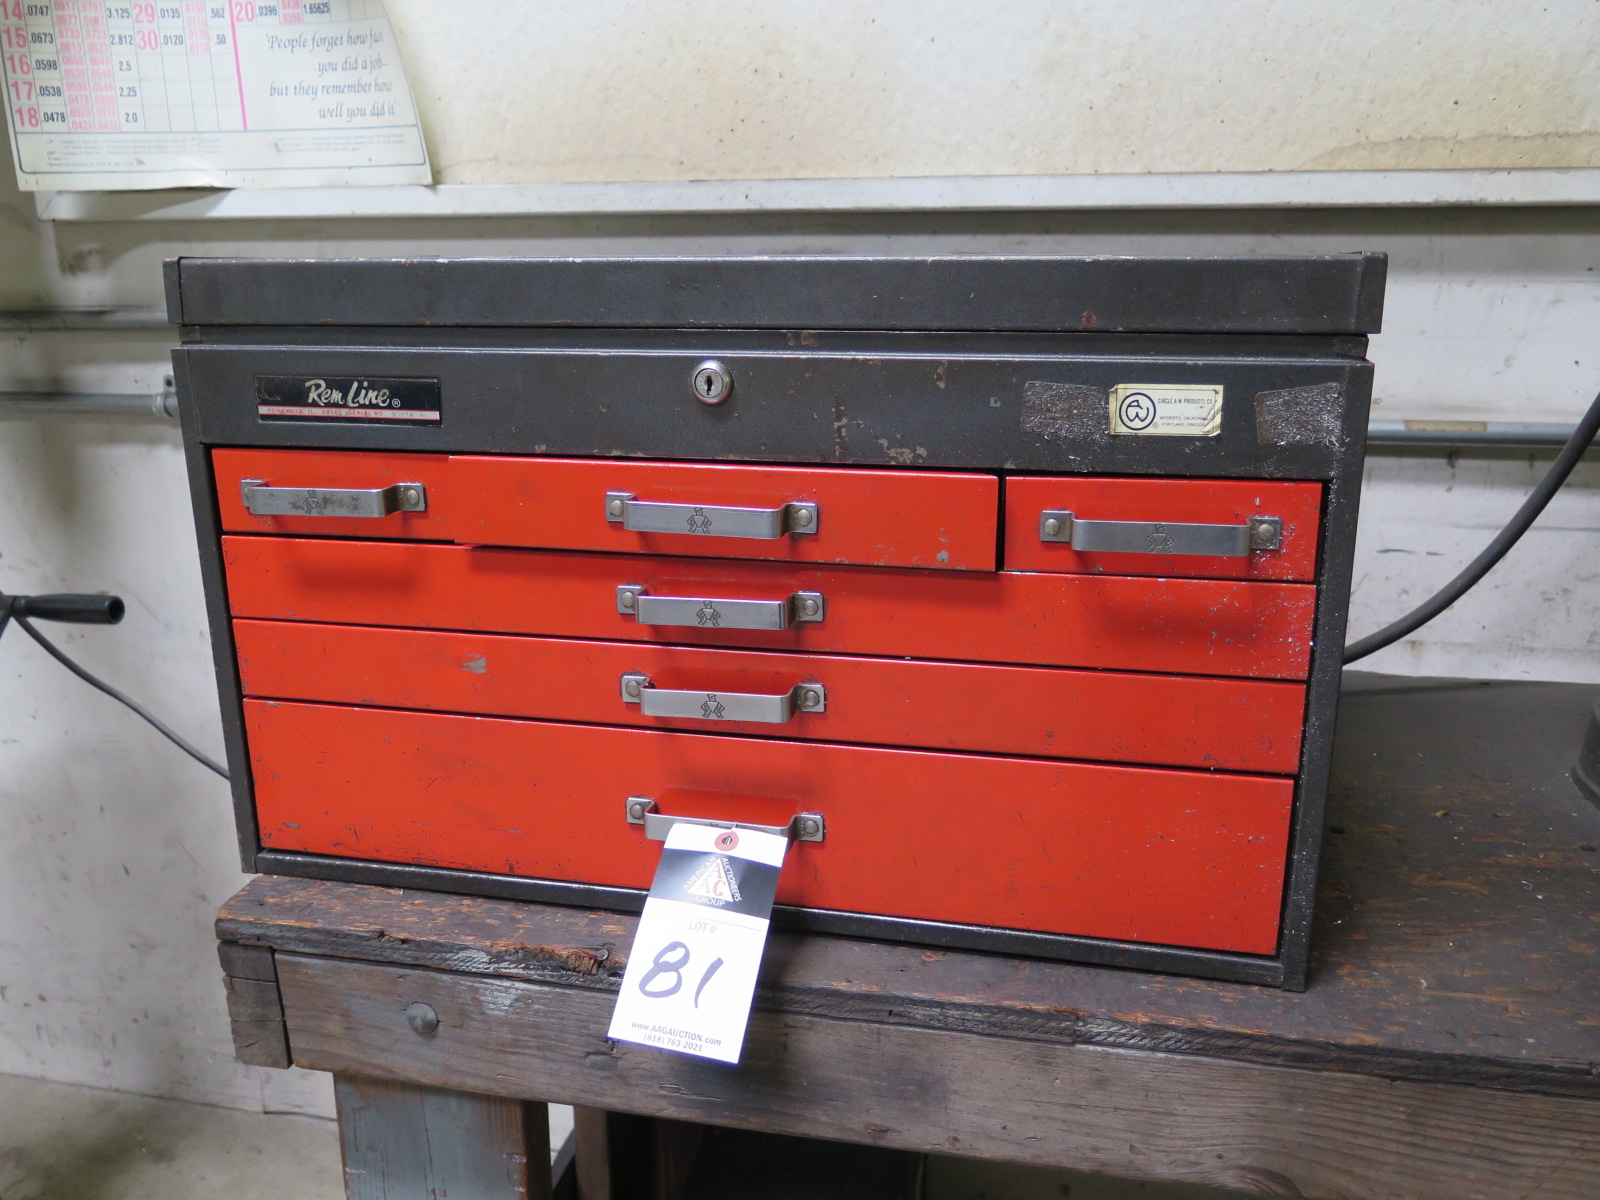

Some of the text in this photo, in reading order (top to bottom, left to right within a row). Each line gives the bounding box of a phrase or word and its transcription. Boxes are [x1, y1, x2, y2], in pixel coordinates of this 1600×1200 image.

[0, 0, 49, 21] 14 .0747
[107, 7, 131, 19] 3.125
[133, 3, 156, 24] 29
[158, 7, 181, 19] .0135
[234, 1, 255, 22] 20
[257, 5, 278, 16] .0396
[2, 27, 54, 48] 15 .0673
[110, 30, 184, 51] 2.812 30 .0120
[214, 34, 227, 45] .50
[309, 30, 344, 53] forget
[347, 29, 367, 46] how
[6, 54, 58, 76] 16 .0598
[118, 60, 132, 72] 2.5
[317, 61, 338, 78] you
[342, 55, 359, 71] did
[361, 59, 368, 71] a
[10, 80, 62, 101] 17 .0538
[119, 86, 137, 98] 2.25
[269, 76, 393, 100] but they remember how
[15, 107, 66, 128] 18 .0478
[124, 112, 138, 123] 2.0
[318, 102, 344, 119] well
[346, 105, 367, 123] you
[370, 100, 386, 118] did
[304, 379, 345, 407] Rem
[683, 856, 717, 891] AMERICAN
[721, 857, 743, 902] AUCTIONEERS
[695, 896, 726, 907] GROUP
[688, 919, 717, 935] LOT #
[639, 941, 724, 1009] 81
[631, 1021, 722, 1047] www.AAGAUCTION.com
[643, 1034, 703, 1052] (818) 763-2021
